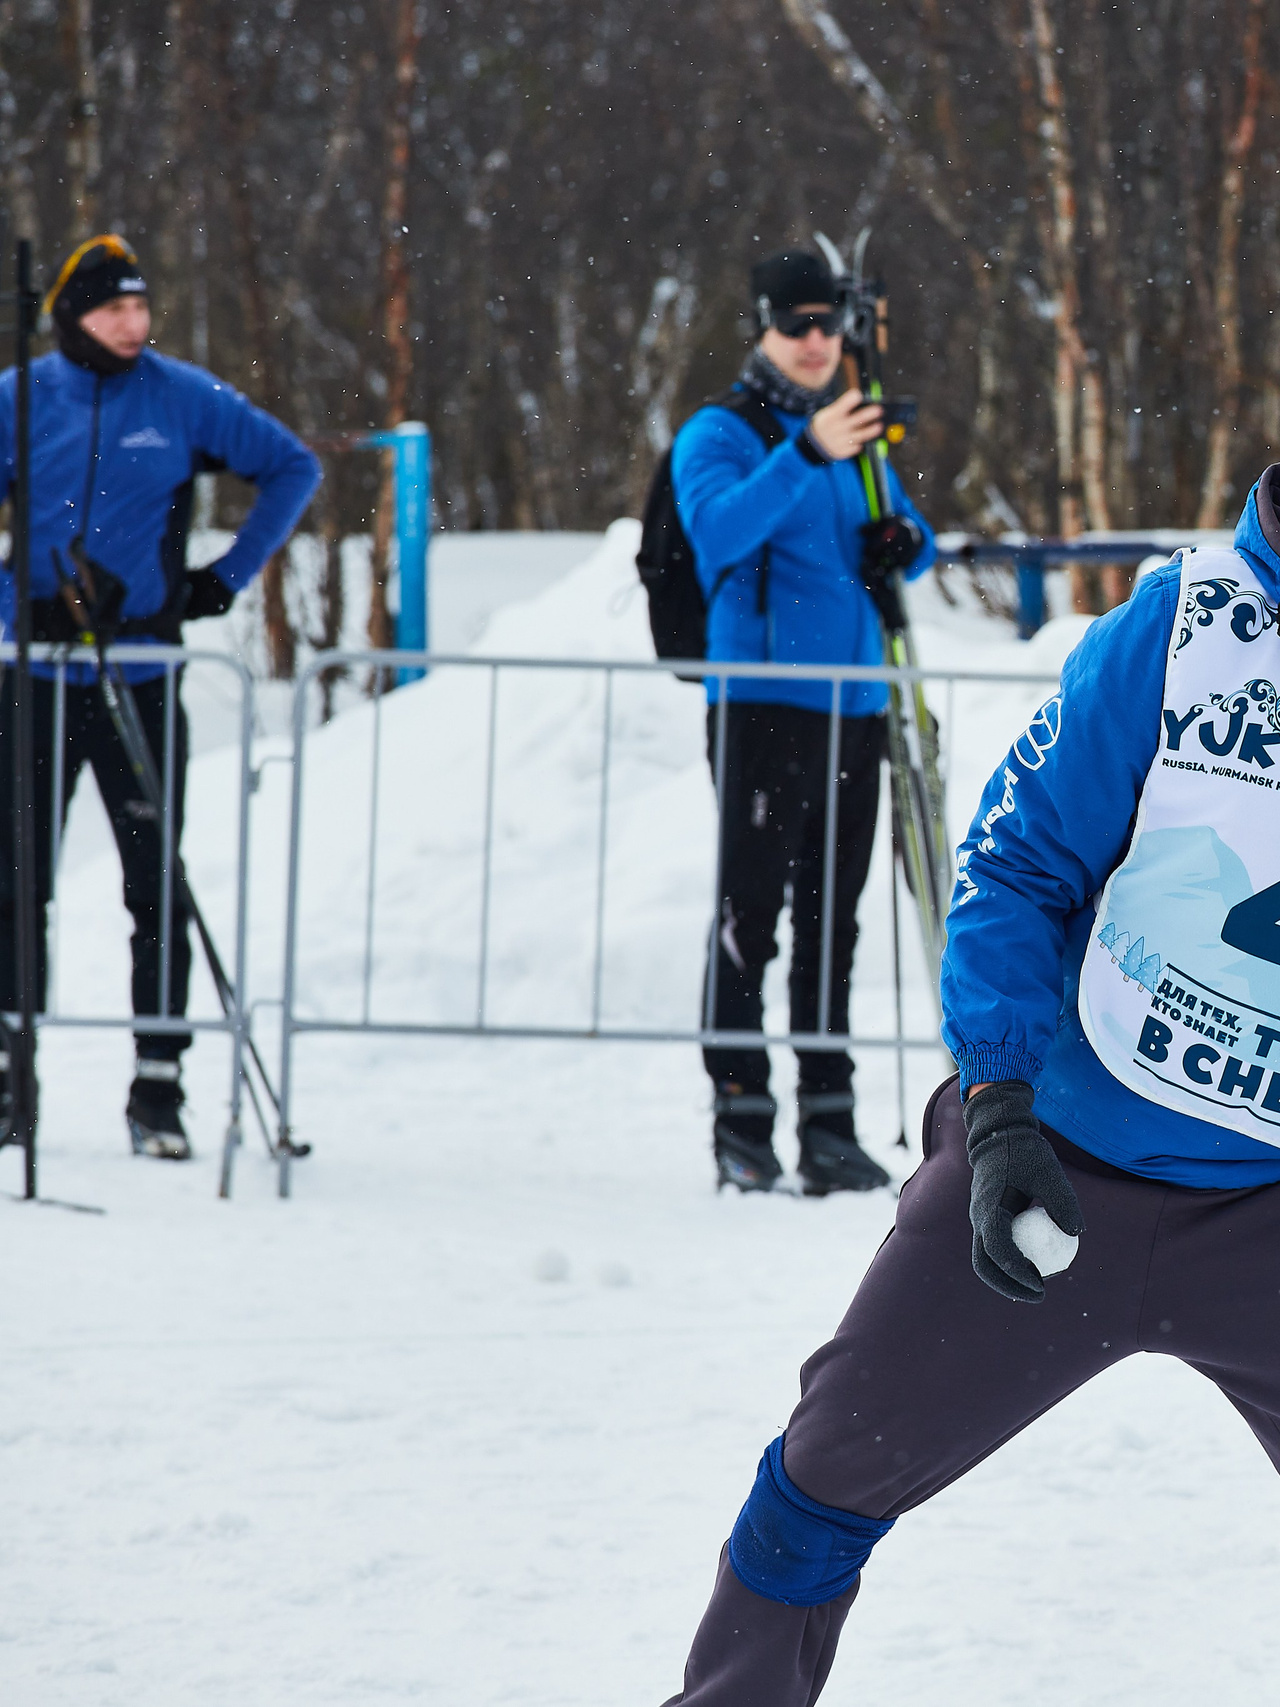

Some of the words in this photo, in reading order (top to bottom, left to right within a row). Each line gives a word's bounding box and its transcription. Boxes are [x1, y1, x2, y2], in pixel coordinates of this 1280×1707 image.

[1161, 757, 1209, 775] RUSSIA,
[1211, 765, 1274, 789] MURMANSK
[1151, 996, 1182, 1022] КТО
[1182, 1014, 1240, 1048] ЗНАЕТ
[1157, 978, 1198, 1011] ДЛЯ
[1199, 1000, 1243, 1034] ТЕХ,
[1136, 1014, 1174, 1063] В
